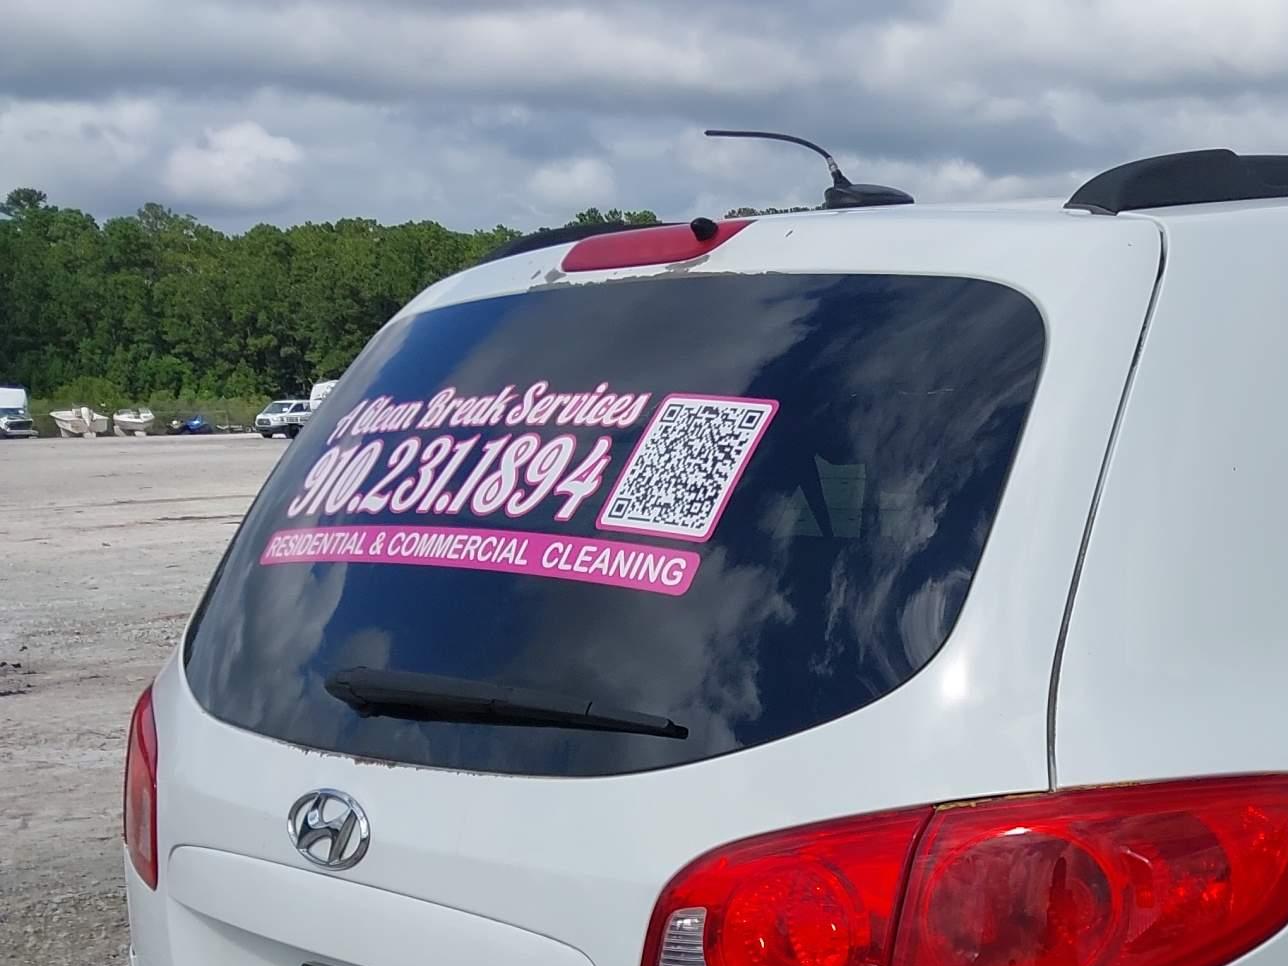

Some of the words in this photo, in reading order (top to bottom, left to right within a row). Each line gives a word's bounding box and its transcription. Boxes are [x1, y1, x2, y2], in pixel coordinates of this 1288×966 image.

[327, 400, 363, 445] A
[354, 394, 425, 437] Clean
[417, 385, 517, 430] Break
[505, 380, 652, 429] Services
[287, 433, 612, 522] 910.231.1894
[265, 531, 366, 559] RESIDENTIAL
[369, 531, 386, 555] &
[387, 532, 528, 566] COMMERCIAL
[541, 541, 688, 586] CLEANING
